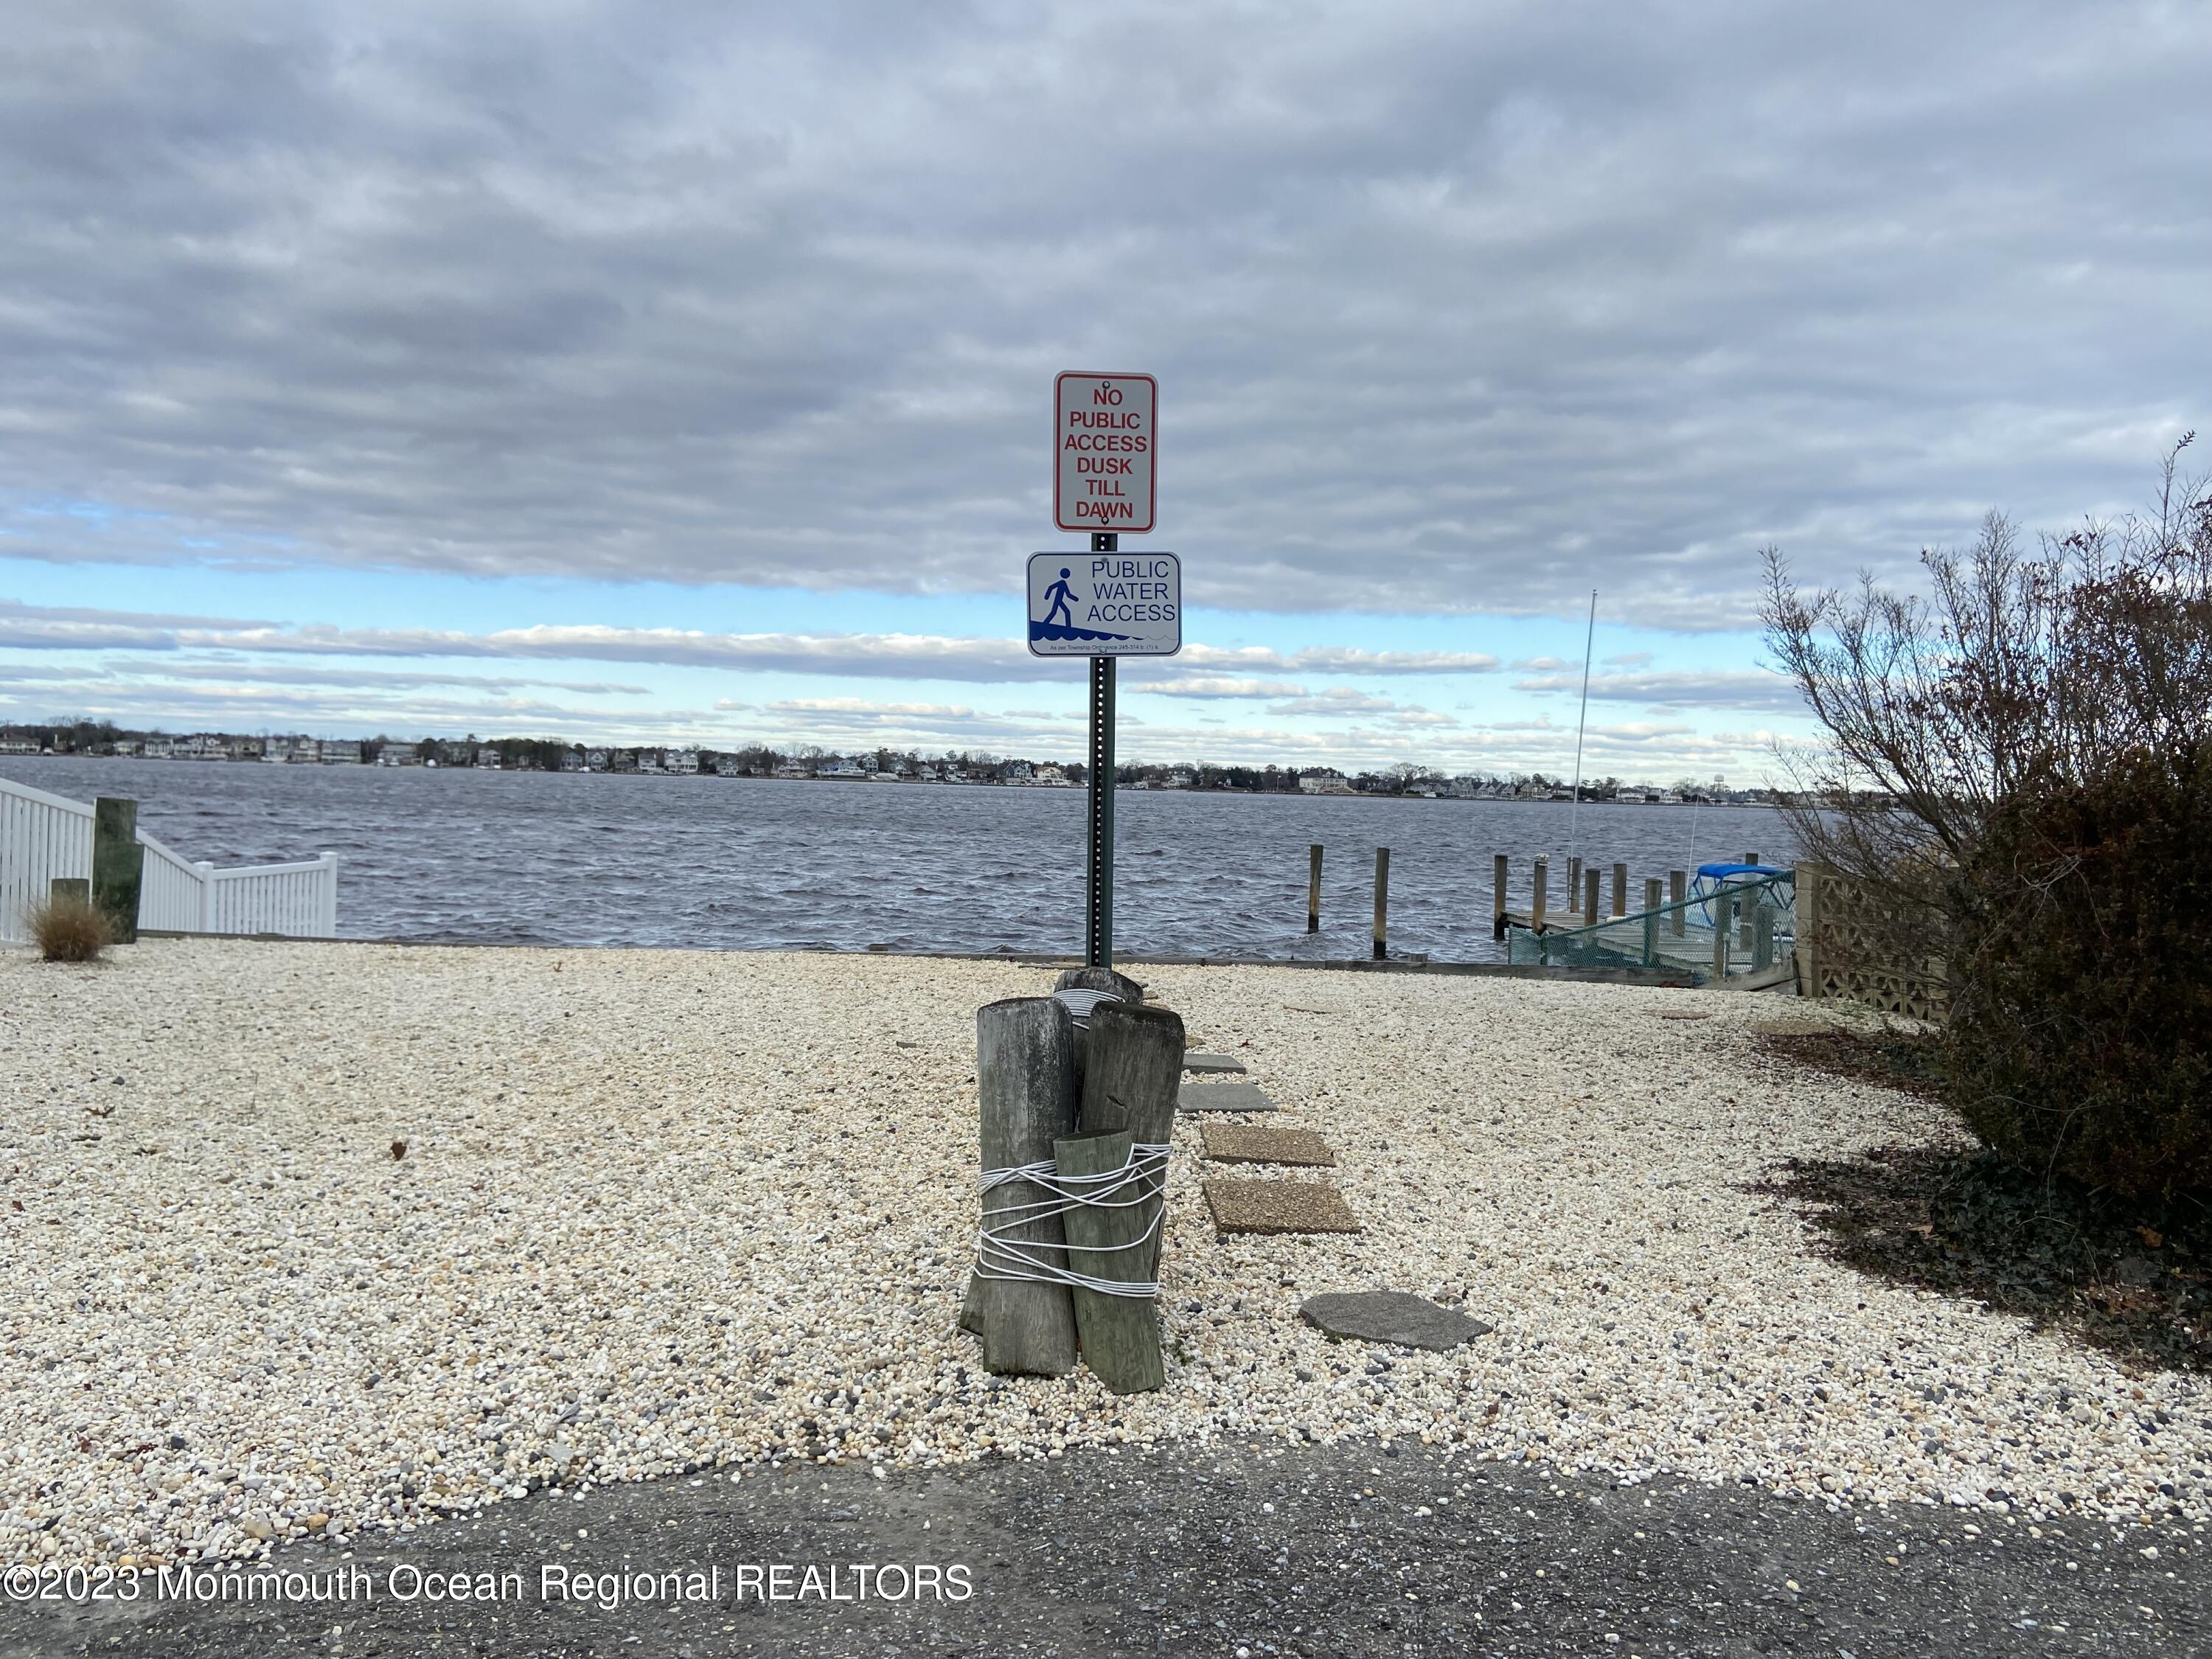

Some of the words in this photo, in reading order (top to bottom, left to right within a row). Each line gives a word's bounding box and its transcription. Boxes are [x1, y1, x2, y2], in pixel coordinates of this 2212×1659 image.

[1093, 389, 1123, 406] NO
[1070, 411, 1141, 429] PUBLIC
[1064, 434, 1147, 452] ACCESS
[1077, 457, 1133, 474] DUSK
[1085, 479, 1125, 496] TILL
[1076, 501, 1133, 518] DAWN
[1092, 561, 1169, 578] PUBLIC
[1093, 582, 1169, 599] WATER
[1087, 605, 1176, 622] ACCESS
